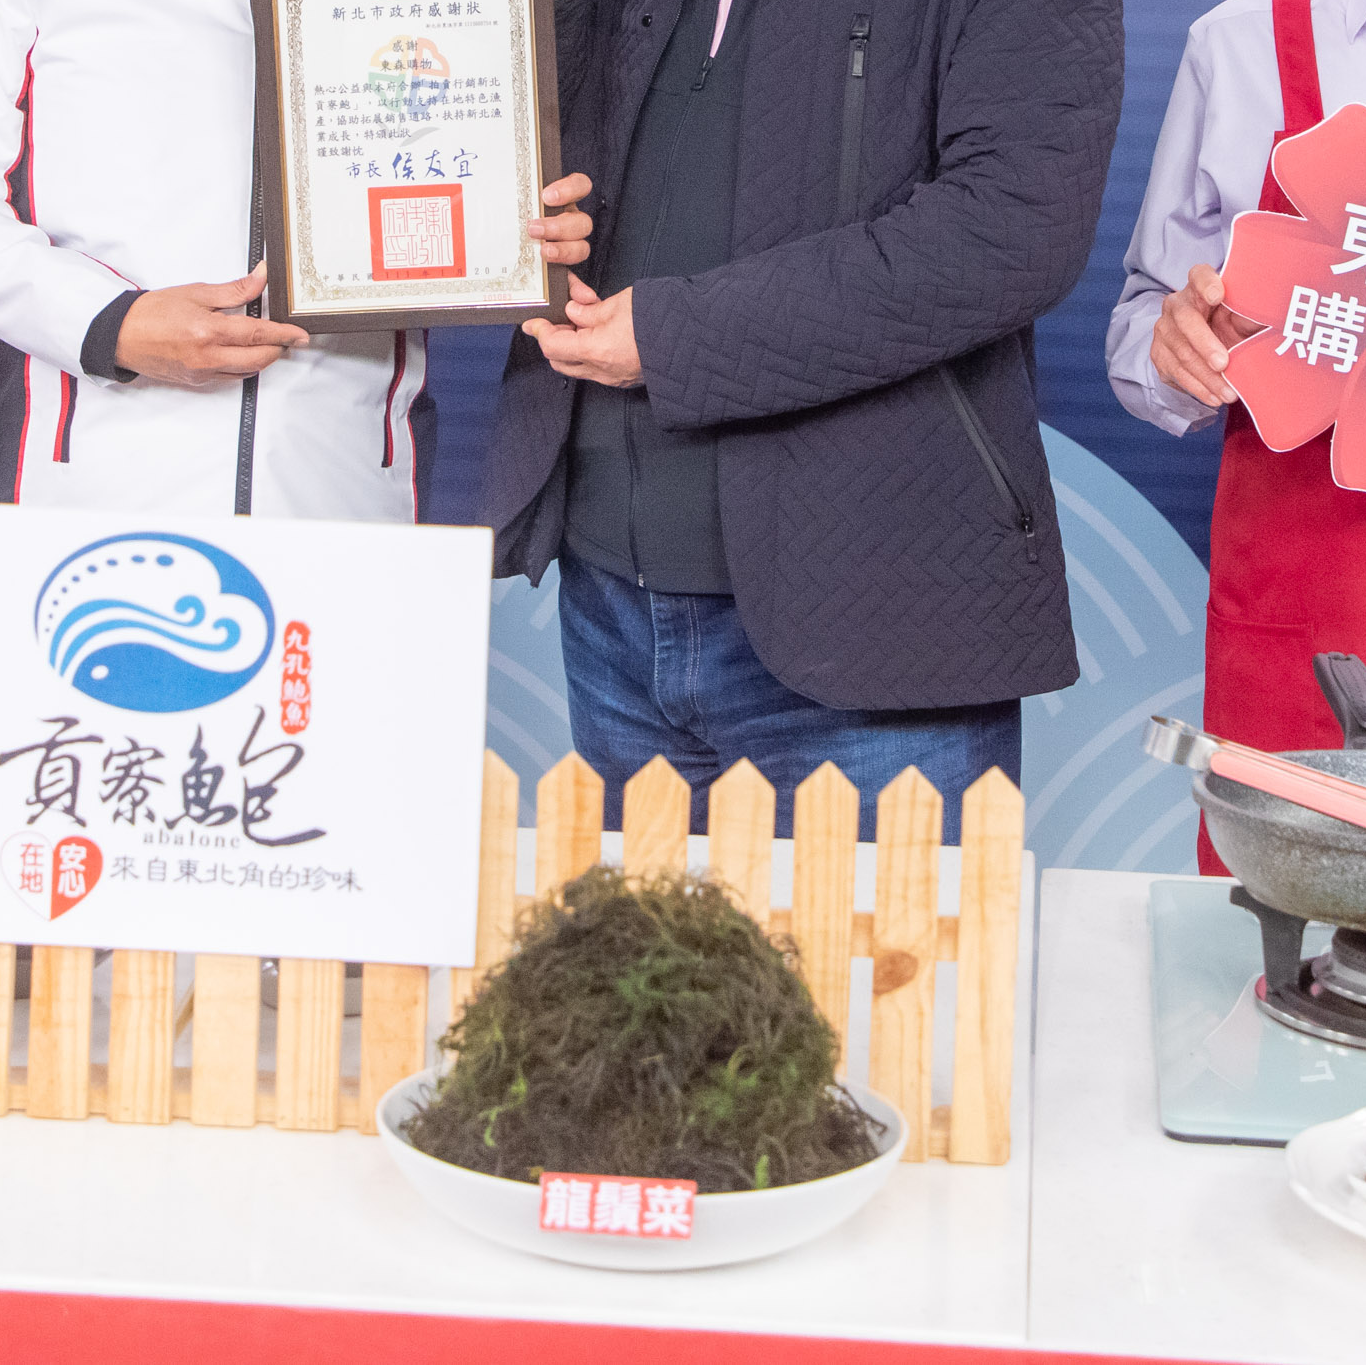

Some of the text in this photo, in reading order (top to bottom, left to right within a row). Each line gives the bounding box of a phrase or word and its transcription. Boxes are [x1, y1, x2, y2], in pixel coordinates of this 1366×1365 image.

[332, 1, 482, 21] 新北市政府感謝狀
[392, 40, 418, 52] 感謝
[380, 58, 433, 72] 東森購物
[345, 148, 478, 181] 市長 侯友宜
[282, 629, 310, 727] 九孔鮑魚
[143, 830, 242, 849] abalone
[19, 843, 44, 894] 在地
[58, 843, 87, 899] 安心
[108, 855, 363, 894] 來自東北角的珍味
[543, 1178, 693, 1235] 龍鬚菜
